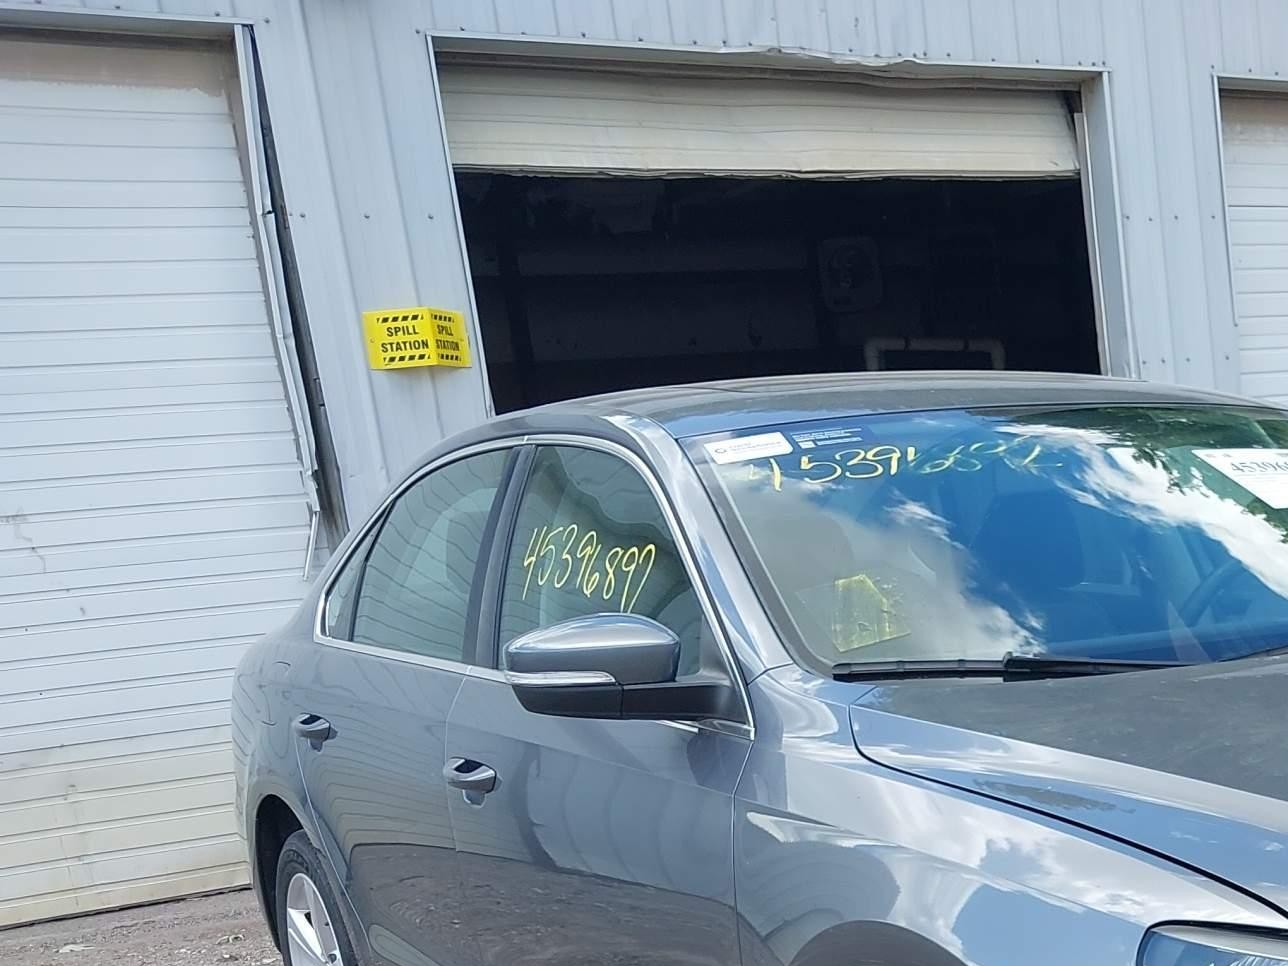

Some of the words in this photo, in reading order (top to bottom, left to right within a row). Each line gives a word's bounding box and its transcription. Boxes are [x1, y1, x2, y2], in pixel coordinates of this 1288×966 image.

[386, 324, 420, 337] SPILL
[436, 324, 454, 336] SPILL
[380, 338, 429, 353] STATION
[435, 338, 460, 351] STATION
